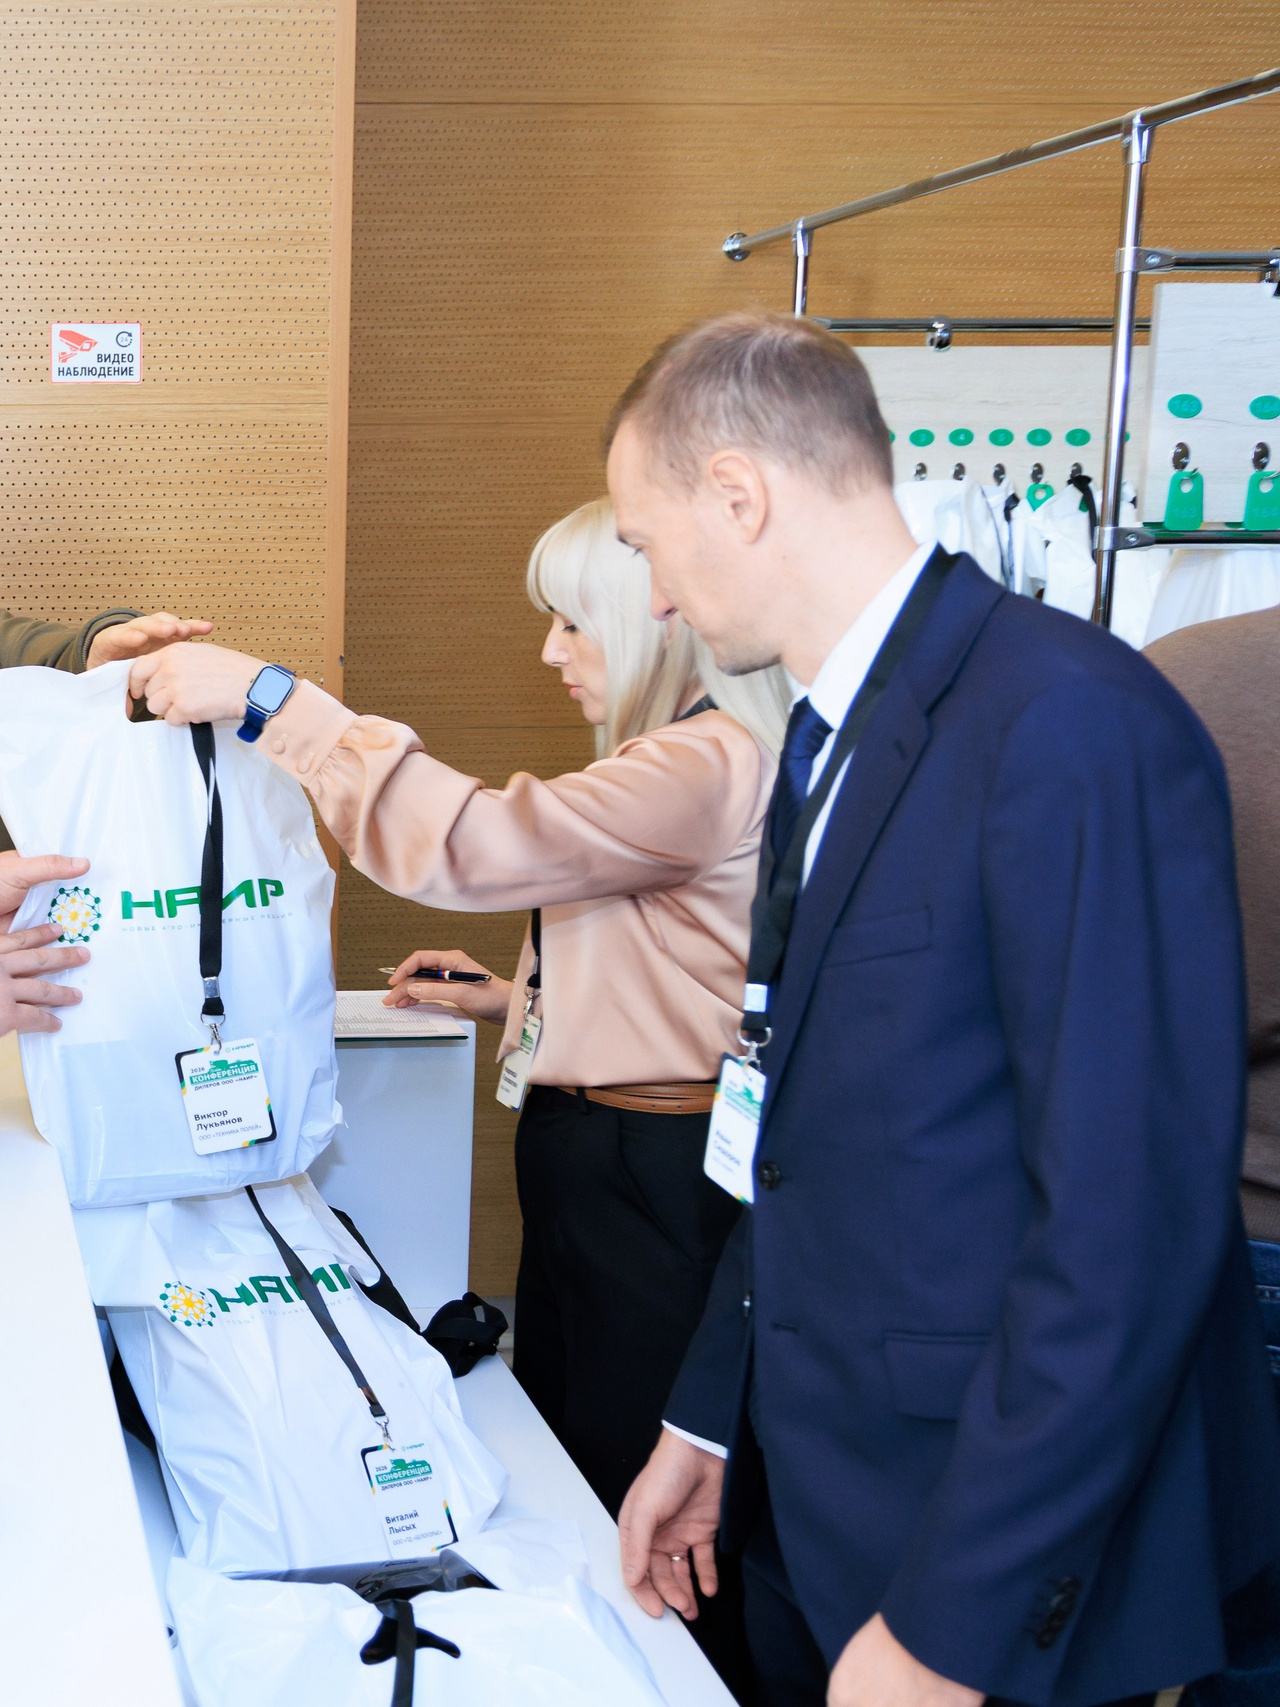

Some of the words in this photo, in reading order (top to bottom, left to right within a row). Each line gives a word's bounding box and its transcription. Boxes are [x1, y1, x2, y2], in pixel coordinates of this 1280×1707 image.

[97, 353, 134, 365] ВИДЕО
[58, 366, 134, 378] НАБЛЮДЕНИЕ
[191, 1064, 257, 1084] КОНФЕРЕНЦИЯ
[194, 1081, 220, 1091] ДИЛЕРОВ
[194, 1109, 228, 1121] Виктор
[196, 1116, 243, 1131] Лукьянов
[377, 1465, 430, 1482] КОНФЕРЕНЦИЯ
[381, 1480, 403, 1491] ДИЛЕРОВ
[385, 1509, 419, 1524] Виталий
[389, 1523, 417, 1535] Лысых
